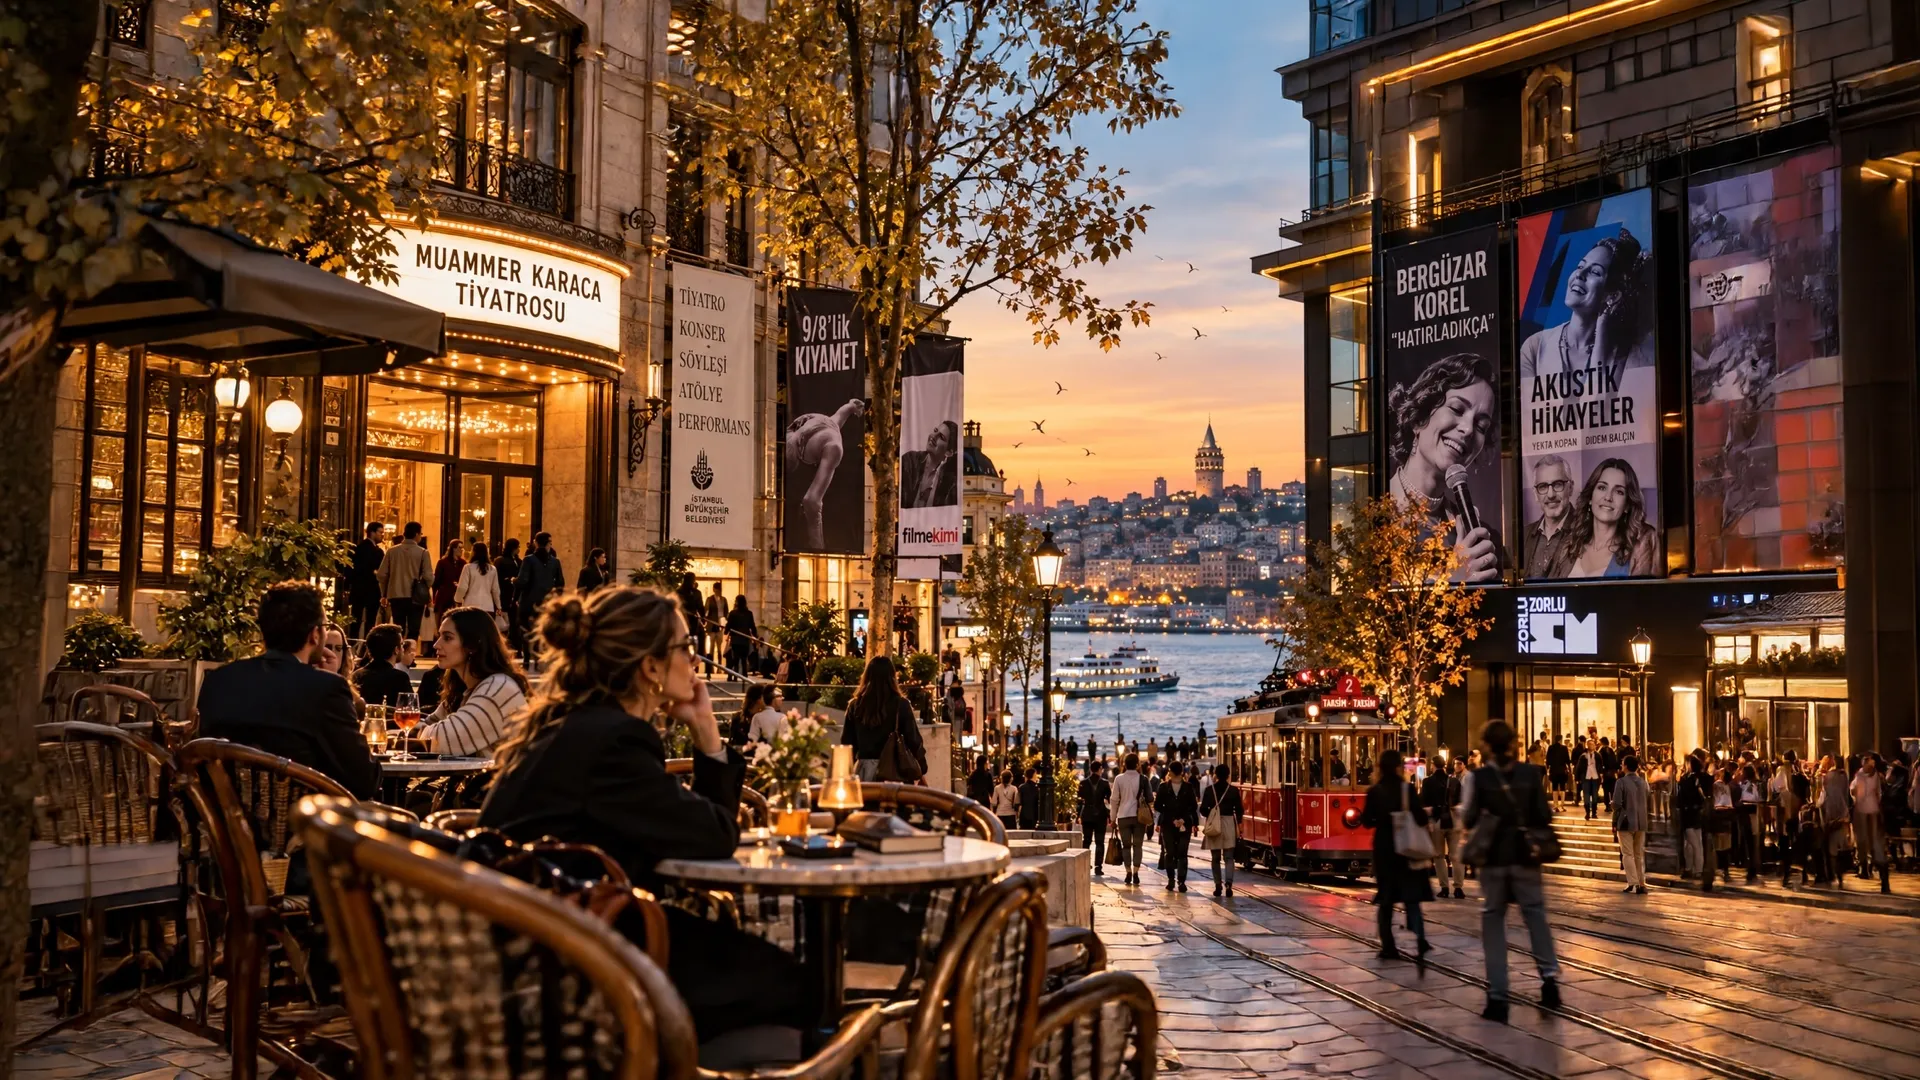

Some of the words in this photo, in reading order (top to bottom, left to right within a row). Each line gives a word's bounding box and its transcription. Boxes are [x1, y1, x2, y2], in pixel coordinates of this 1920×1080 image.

[416, 243, 521, 284] MUAMMER
[532, 264, 602, 302] KARACA
[1396, 250, 1487, 296] BERGÜZAR
[456, 279, 565, 323] TİYATROSU
[680, 287, 726, 312] TİYATRO
[1414, 285, 1470, 322] KOREL
[680, 319, 726, 343] KONSER
[679, 350, 727, 377] SÖYLEŞİ
[795, 341, 859, 376] KIYAMET
[679, 381, 723, 403] ATÖLYE
[1531, 361, 1619, 403] AKUSTİK
[678, 412, 751, 437] PERFORMANS
[1532, 396, 1635, 436] HİKAYELER
[1532, 440, 1552, 450] YEKTA
[1554, 438, 1577, 448] KOPAN
[902, 527, 959, 544] filmekimi
[1529, 596, 1566, 613] ZORLU
[1517, 596, 1529, 653] ZORLU
[1345, 678, 1353, 693] 2
